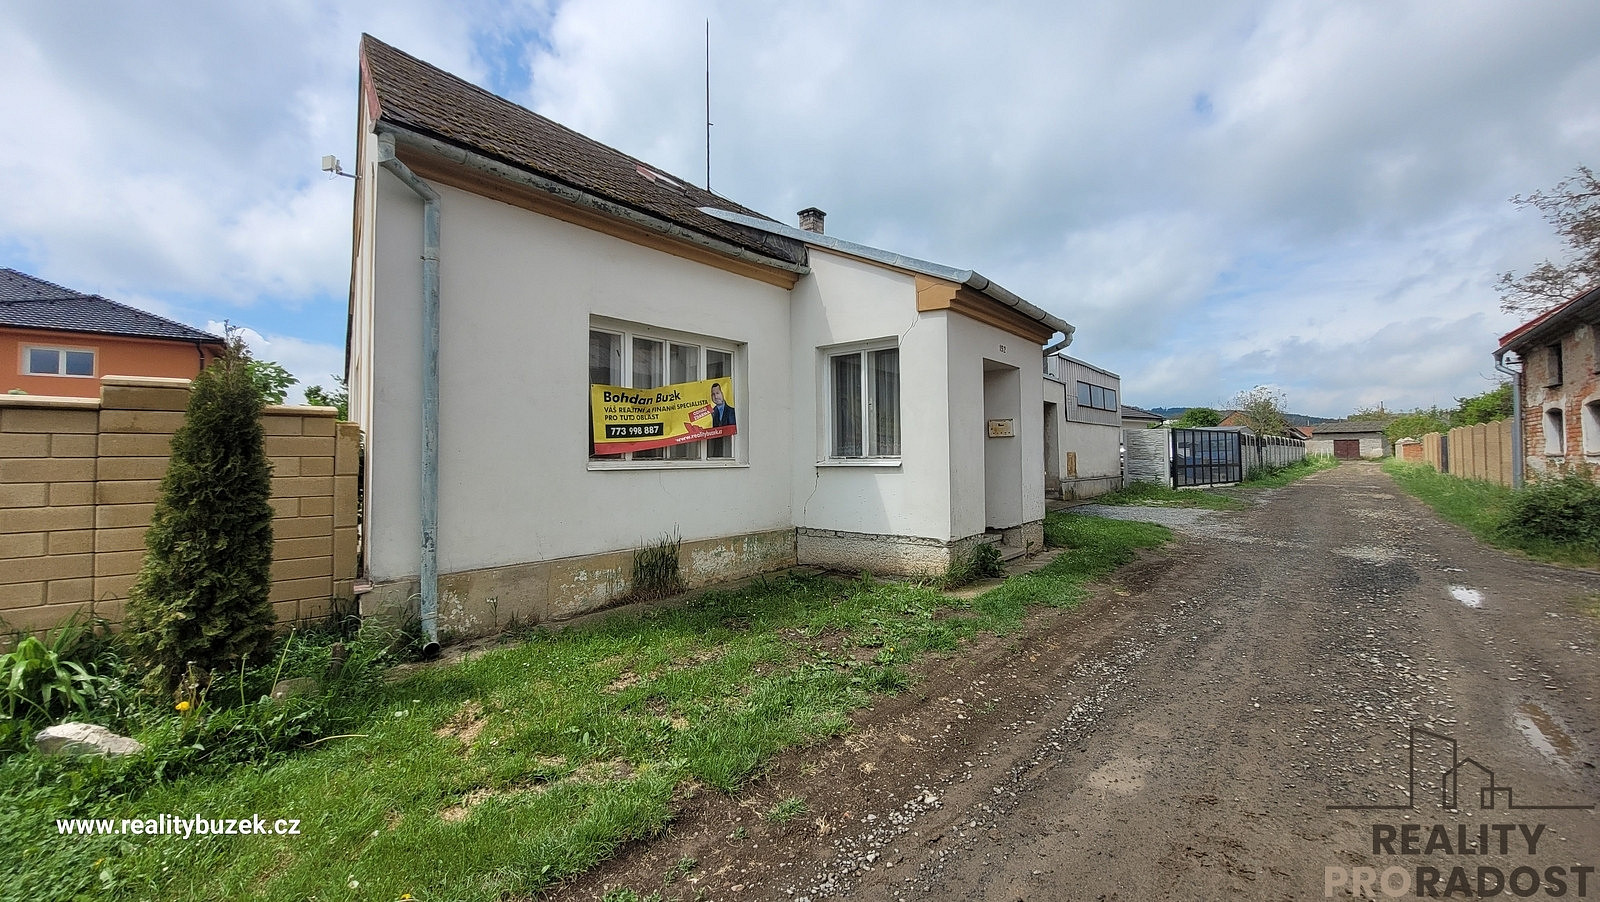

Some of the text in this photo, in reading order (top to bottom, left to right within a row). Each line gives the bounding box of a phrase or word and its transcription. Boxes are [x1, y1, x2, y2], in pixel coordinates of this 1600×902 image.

[603, 391, 653, 405] Bohdan
[604, 405, 617, 413] VÁŠ
[636, 413, 659, 421] OBLAST
[610, 425, 659, 436] 773 998 887
